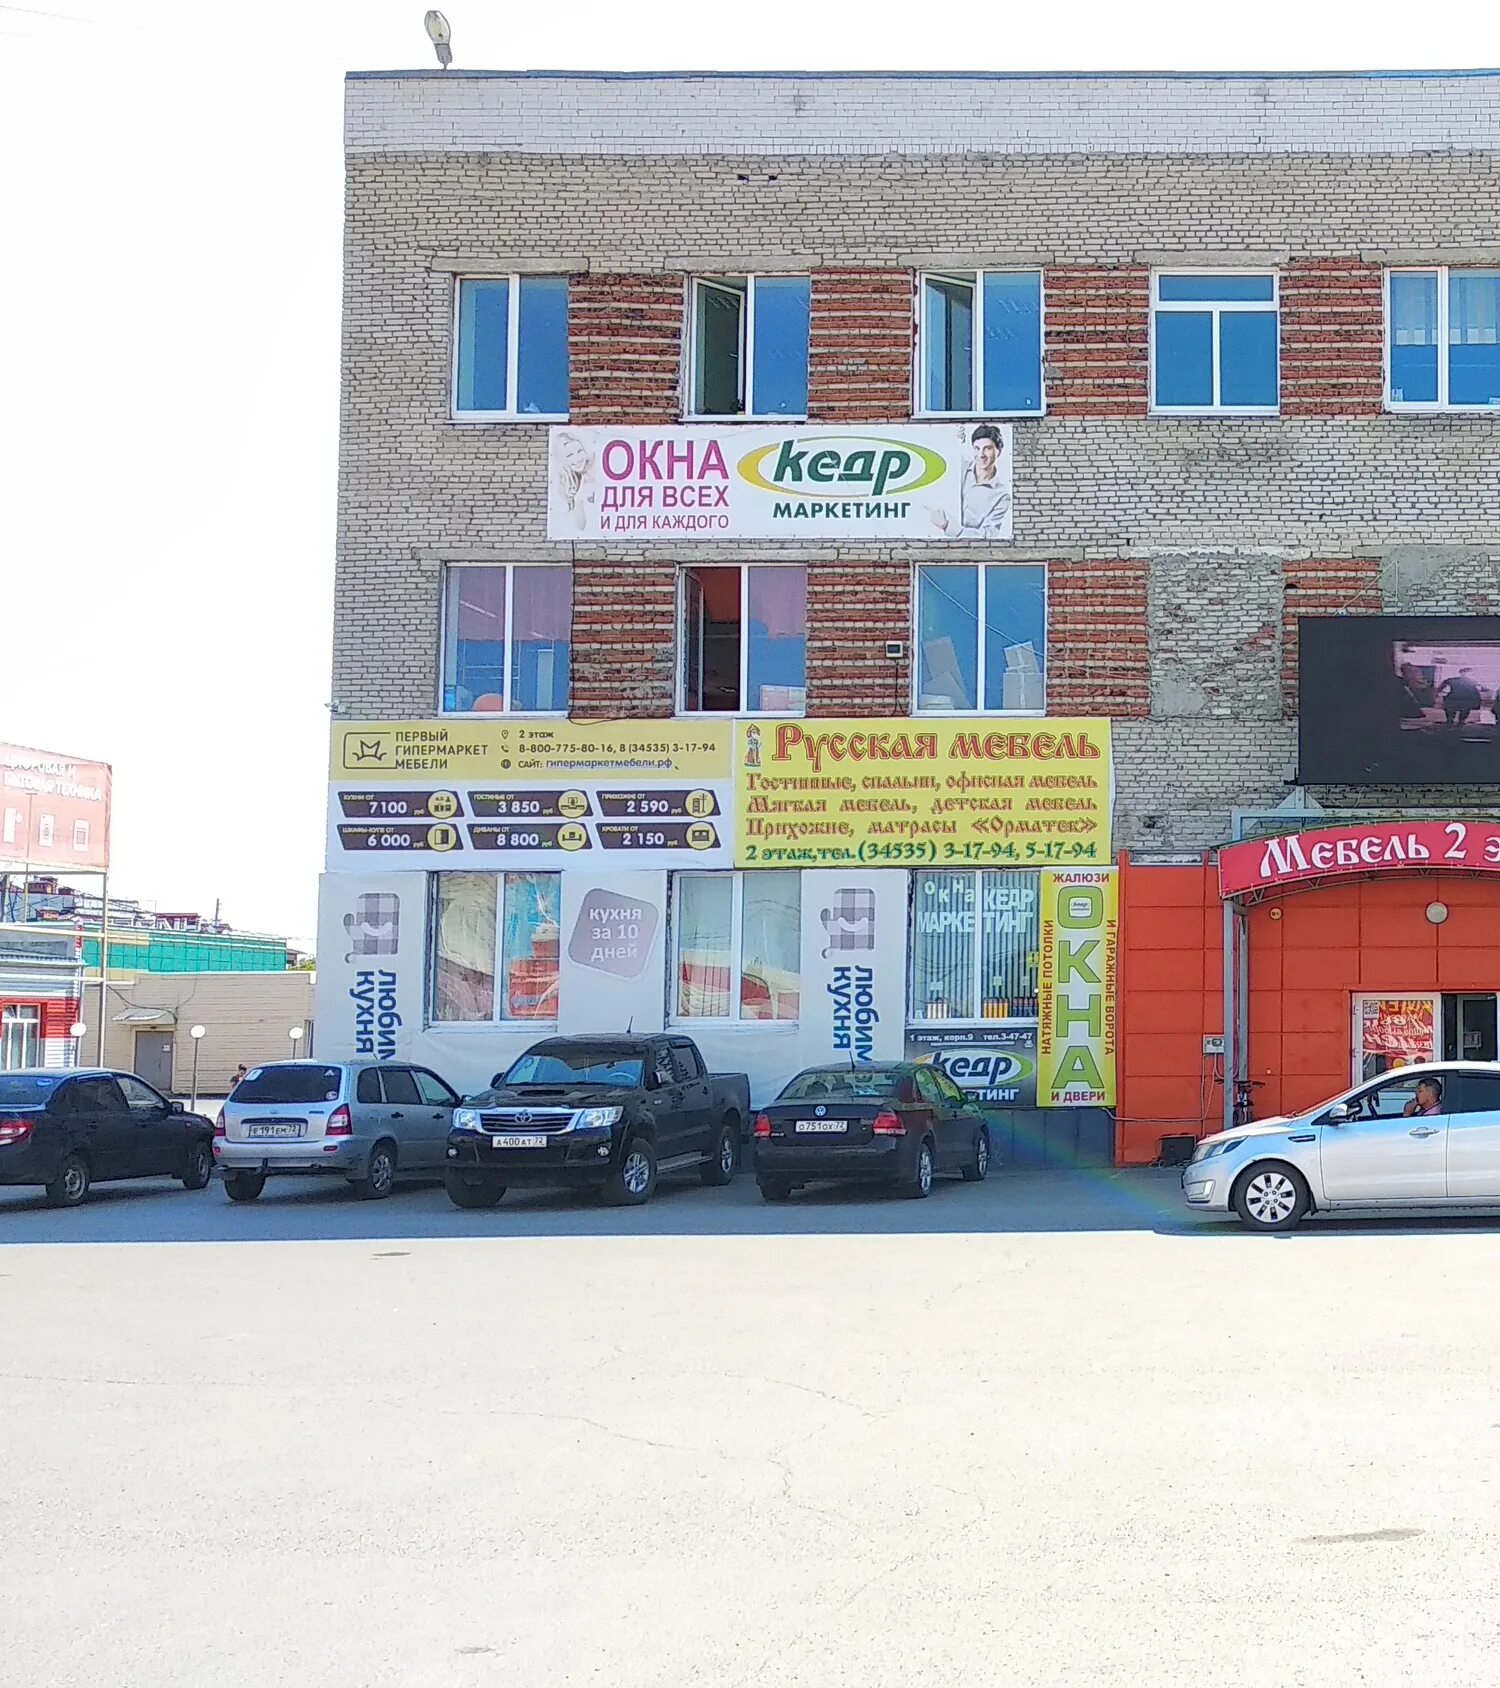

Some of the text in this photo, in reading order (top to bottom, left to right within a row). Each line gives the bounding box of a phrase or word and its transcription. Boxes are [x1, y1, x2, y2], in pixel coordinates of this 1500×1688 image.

[601, 439, 730, 481] ОКНА
[773, 440, 910, 496] кедр
[601, 485, 729, 512] ДЛЯ ВСЕХ
[773, 503, 910, 519] МАРКЕТИНГ
[601, 513, 729, 532] И ДЛЯ КАЖДОГО
[396, 729, 448, 741] ПЕРВЫЙ
[519, 730, 525, 738] 2
[396, 745, 488, 755] ГИПЕРМАРКЕТ
[519, 744, 716, 754] 8-800-775-80-16, 8 (34535) 3-17-94
[396, 759, 448, 769] МЕБЕЛИ
[518, 759, 672, 769] САЙТ: гипермаркетмебели.рф
[945, 771, 1025, 793] офисная
[1029, 775, 1098, 788] мебель
[746, 795, 1097, 814] Мягкая мебель, детская мебель
[746, 818, 854, 840] Прихожие,
[867, 820, 957, 838] матрасы
[746, 841, 1097, 861] 2 3-17-94, 5-17-94
[1259, 832, 1430, 879] Мебель
[1443, 823, 1468, 860] 2
[1053, 873, 1110, 884] ЖАЛЮЗИ
[984, 889, 1034, 910] КЕДР
[589, 907, 642, 923] кухня
[591, 924, 638, 939] за 10
[591, 944, 638, 961] дней
[1042, 920, 1053, 1054] НАТЯЖНЫЕ ПОТОЛКИ
[1051, 884, 1105, 1089] ОКНА
[1105, 932, 1115, 1055] ГАРАЖНЫЕ ВОРОТА
[349, 971, 374, 1053] кухня
[378, 969, 402, 1060] любим
[827, 966, 851, 1049] кухня
[855, 965, 880, 1061] любим
[933, 1052, 1012, 1085] кедр
[1051, 1091, 1105, 1103] И ДВЕРИ
